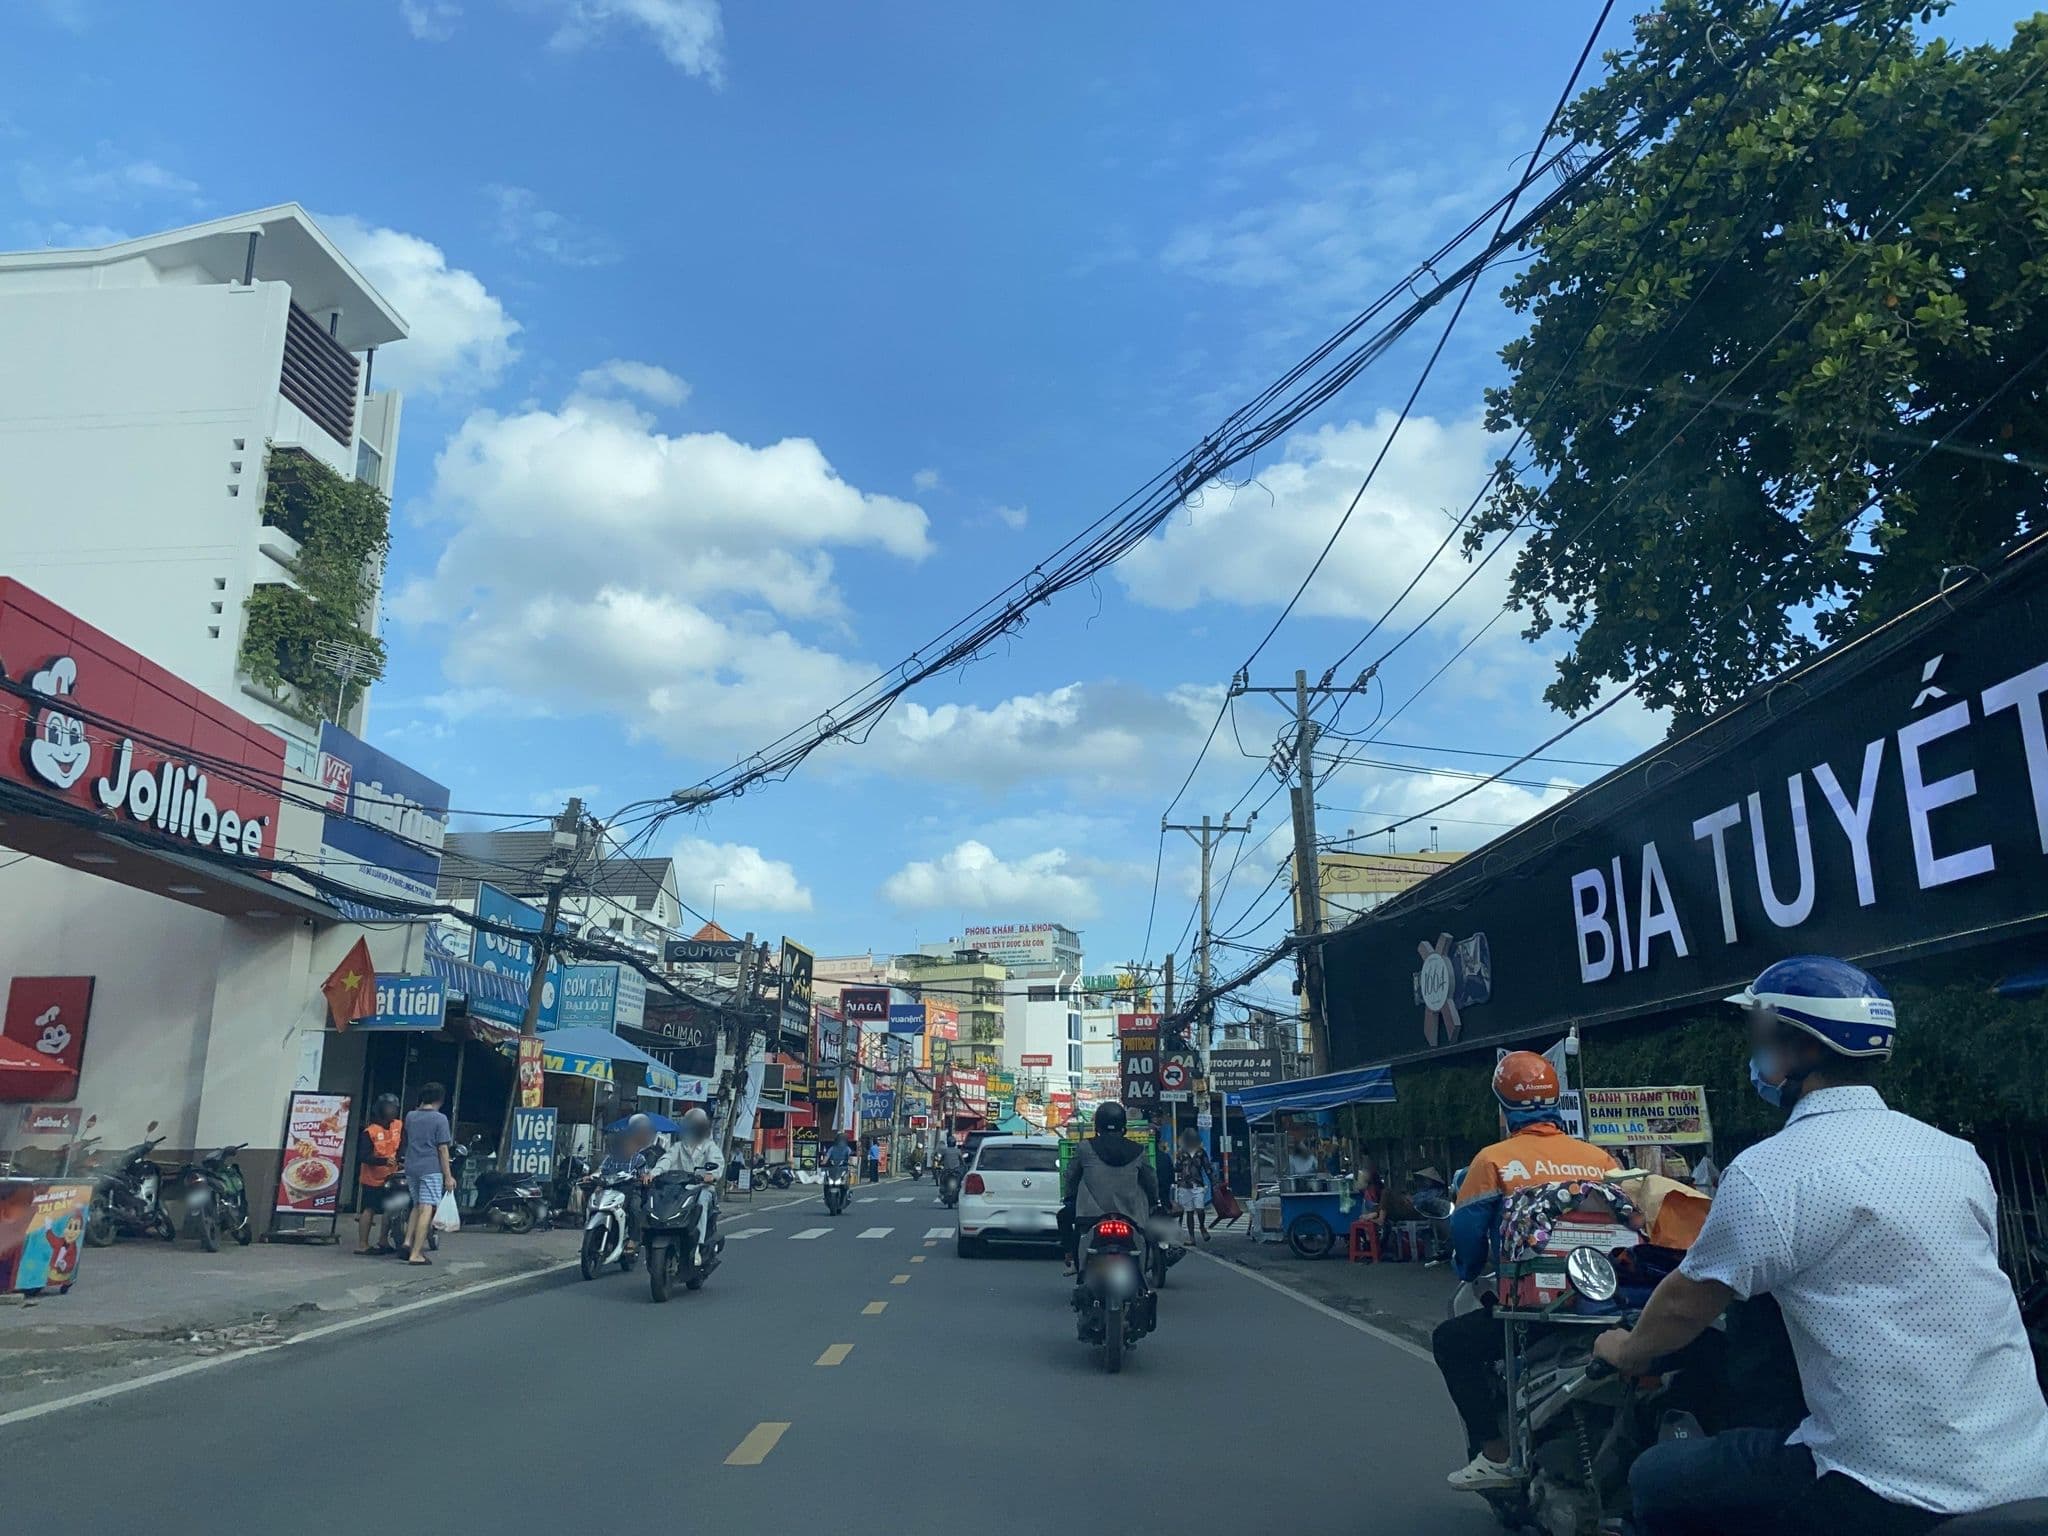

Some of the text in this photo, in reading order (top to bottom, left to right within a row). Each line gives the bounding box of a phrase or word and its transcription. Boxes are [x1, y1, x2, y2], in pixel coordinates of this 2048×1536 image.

[98, 738, 263, 858] Jollibee
[1571, 654, 2048, 984] BIA TUYẾT
[1031, 923, 1053, 932] KHOA
[564, 974, 587, 997] CƠM
[590, 970, 613, 998] TẤM
[399, 985, 440, 1016] tiến
[1127, 1081, 1155, 1098] A4
[516, 1114, 554, 1146] Việt
[512, 1147, 551, 1175] tiến
[1534, 1160, 1605, 1178] Ahamov
